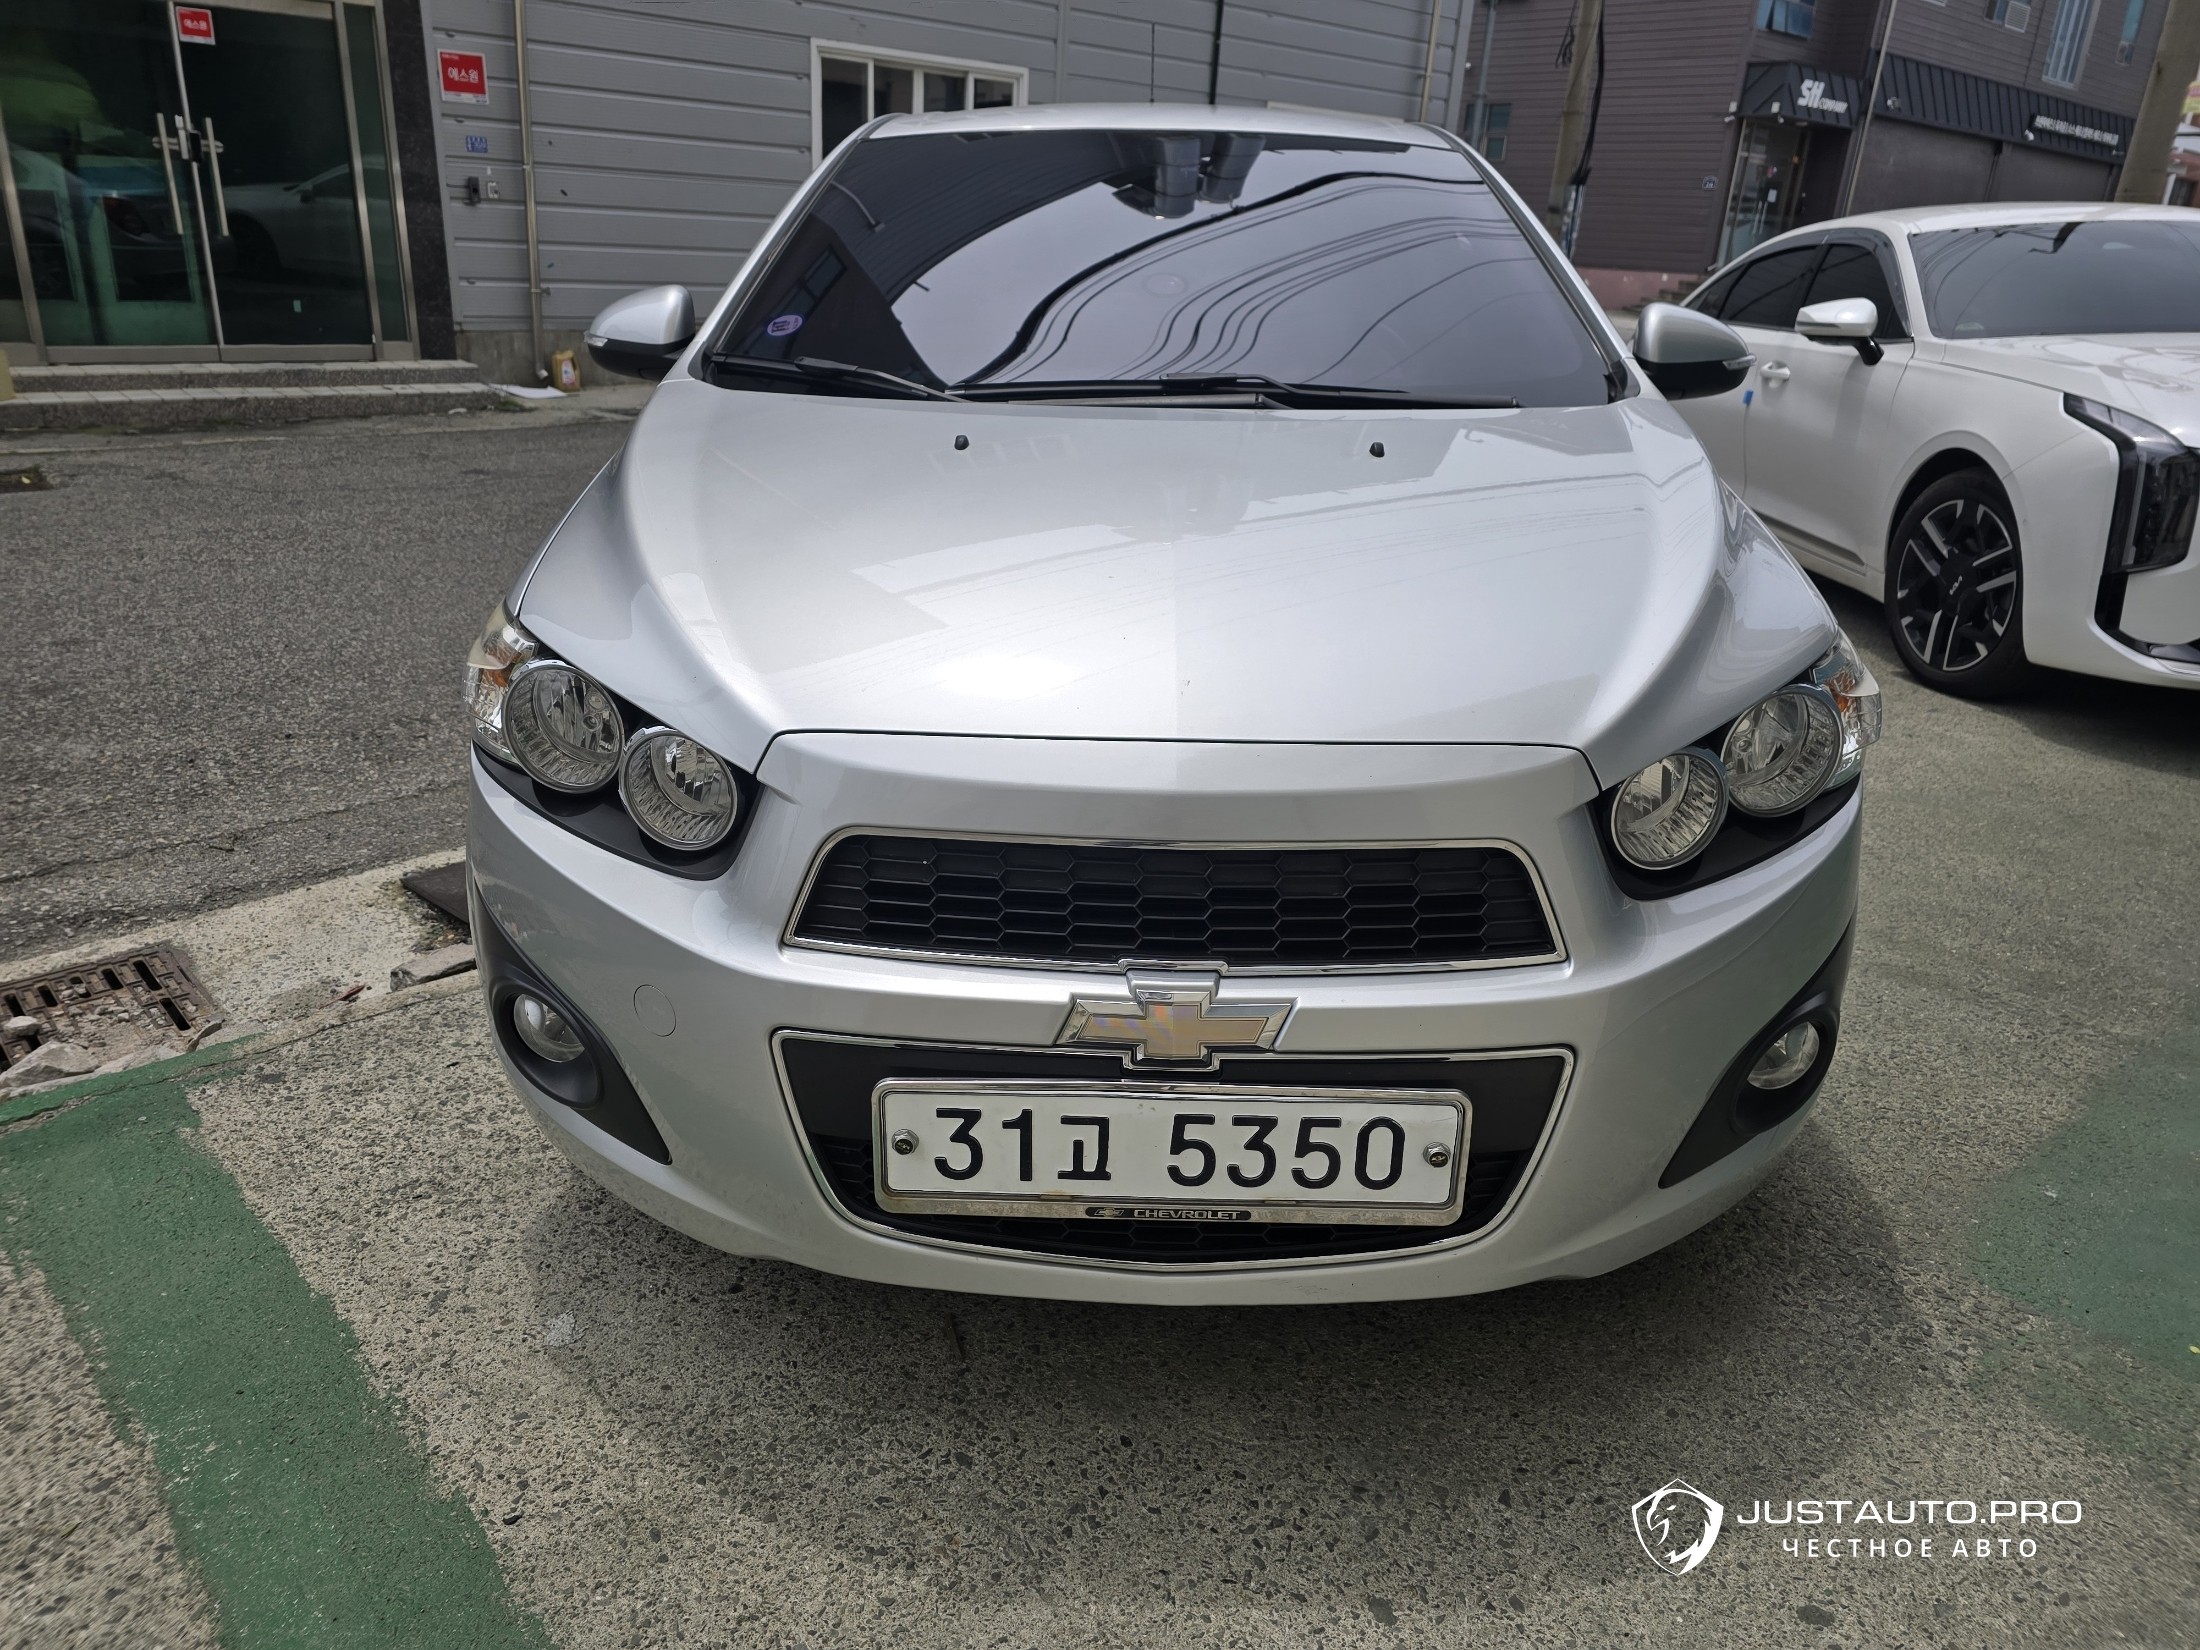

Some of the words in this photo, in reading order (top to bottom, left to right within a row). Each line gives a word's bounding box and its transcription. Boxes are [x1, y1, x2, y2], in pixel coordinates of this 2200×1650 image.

[447, 66, 479, 84] 에스원
[1797, 78, 1826, 109] SH
[933, 1107, 1111, 1182] 31고
[1166, 1113, 1406, 1191] 5350
[1133, 1208, 1241, 1220] CHEVROLET
